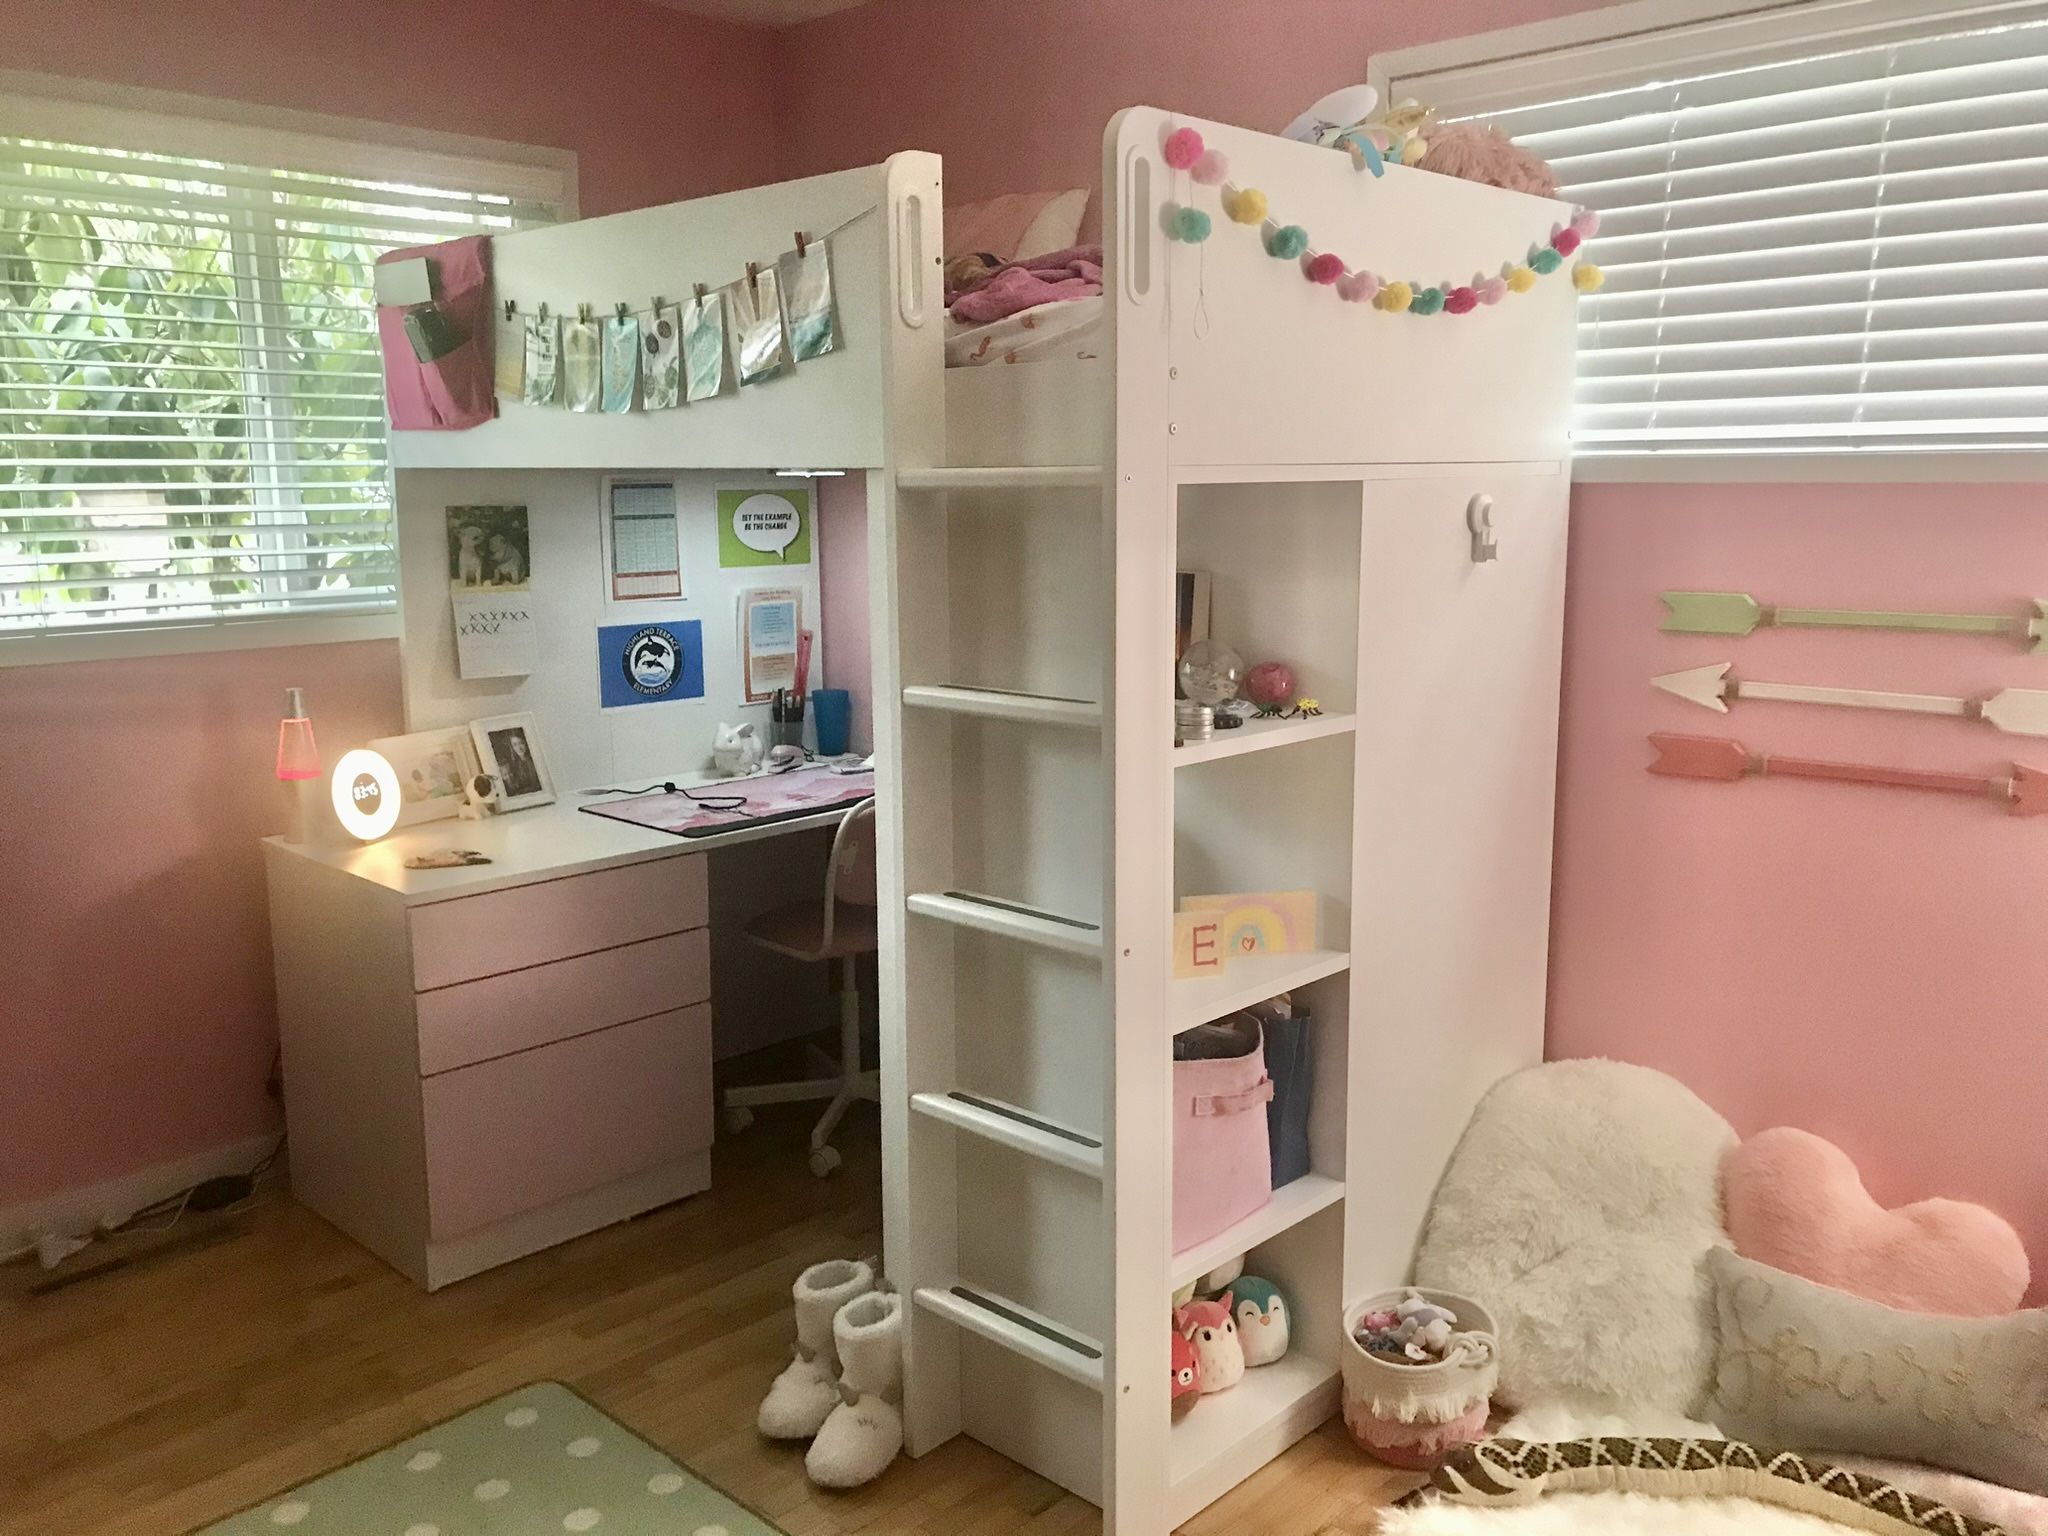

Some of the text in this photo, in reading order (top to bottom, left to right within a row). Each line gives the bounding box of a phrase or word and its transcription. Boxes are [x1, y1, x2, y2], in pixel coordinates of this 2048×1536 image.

[625, 627, 680, 656] HIGHLAND TERRACE
[633, 678, 673, 695] ELEMENTARY
[1193, 923, 1218, 966] E
